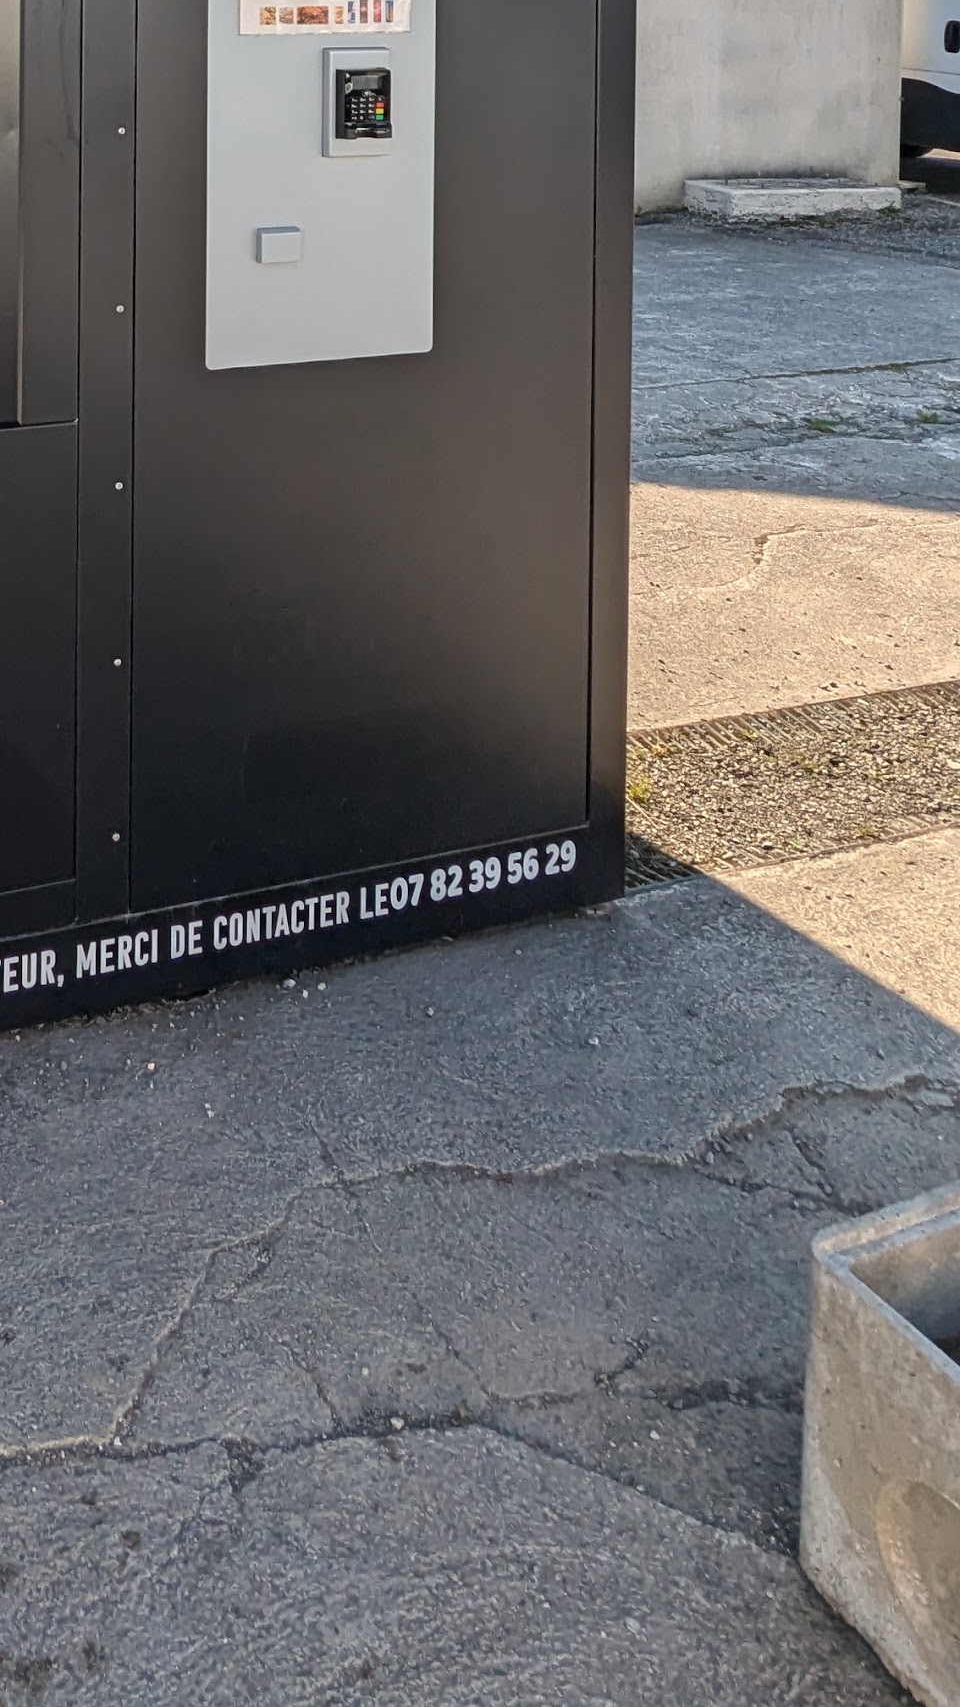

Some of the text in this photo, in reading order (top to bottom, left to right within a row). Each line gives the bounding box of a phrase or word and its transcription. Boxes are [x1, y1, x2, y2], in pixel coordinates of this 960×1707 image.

[75, 928, 160, 979] MERCI
[169, 920, 204, 960] DE
[212, 891, 350, 952] CONTACTER
[429, 864, 463, 902] 82
[468, 856, 502, 893] 39
[506, 847, 540, 885] 56
[544, 839, 577, 876] 29
